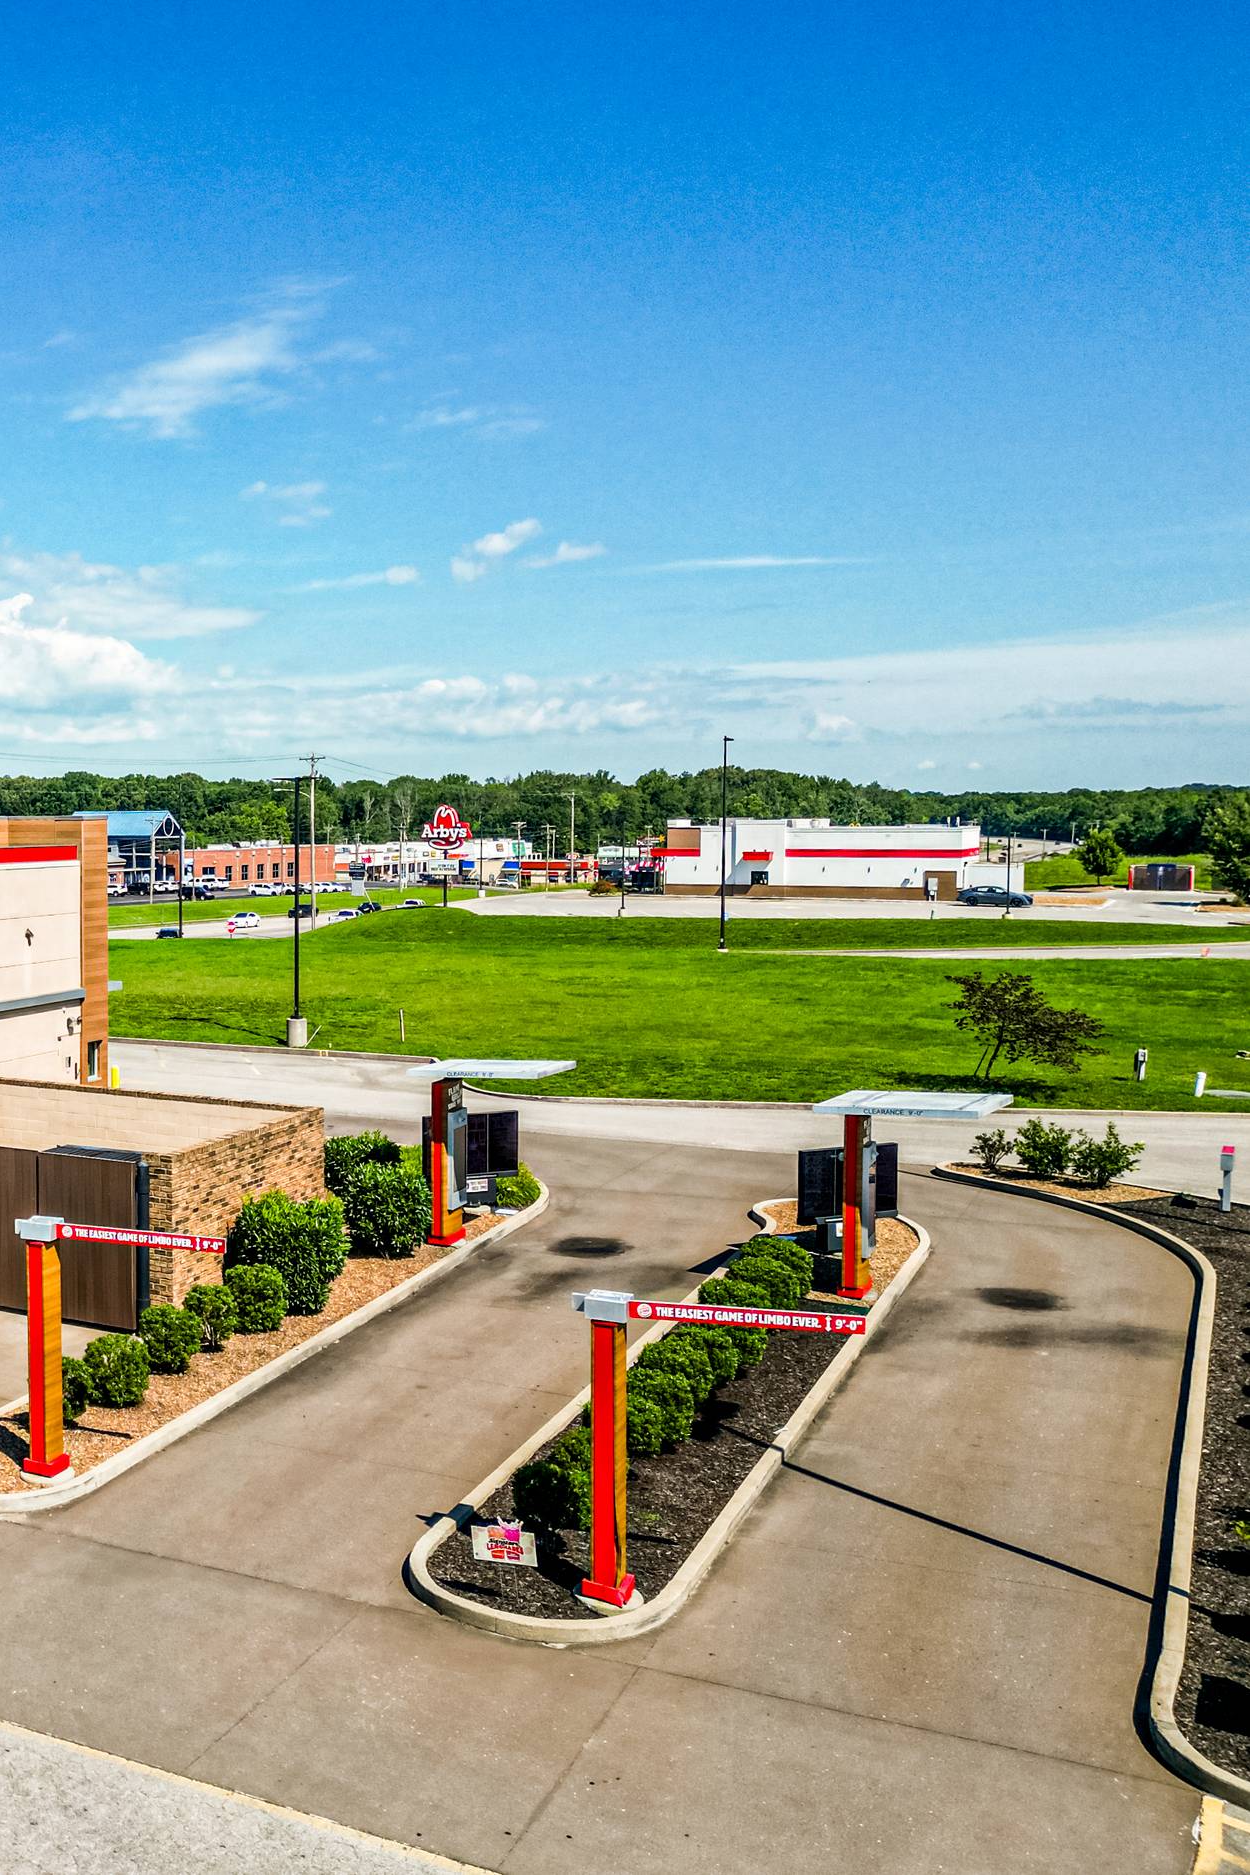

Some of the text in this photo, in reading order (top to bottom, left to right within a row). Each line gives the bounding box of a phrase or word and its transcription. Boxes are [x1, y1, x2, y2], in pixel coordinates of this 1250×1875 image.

[421, 824, 467, 841] Arby's
[863, 1108, 904, 1116] CLEARANCE
[75, 1228, 88, 1238] THE
[89, 1230, 117, 1240] EASIEST
[117, 1232, 138, 1242] GAME
[138, 1234, 148, 1243] OF
[148, 1235, 172, 1246] LIMBO
[172, 1237, 193, 1248] EVER.
[655, 1306, 674, 1317] THE
[675, 1308, 714, 1320] EASIEST
[714, 1311, 744, 1323] GAME
[744, 1313, 758, 1324] OF
[758, 1314, 791, 1326] LIMBO
[792, 1316, 822, 1328] EVER.
[835, 1319, 863, 1331] 9'-0"
